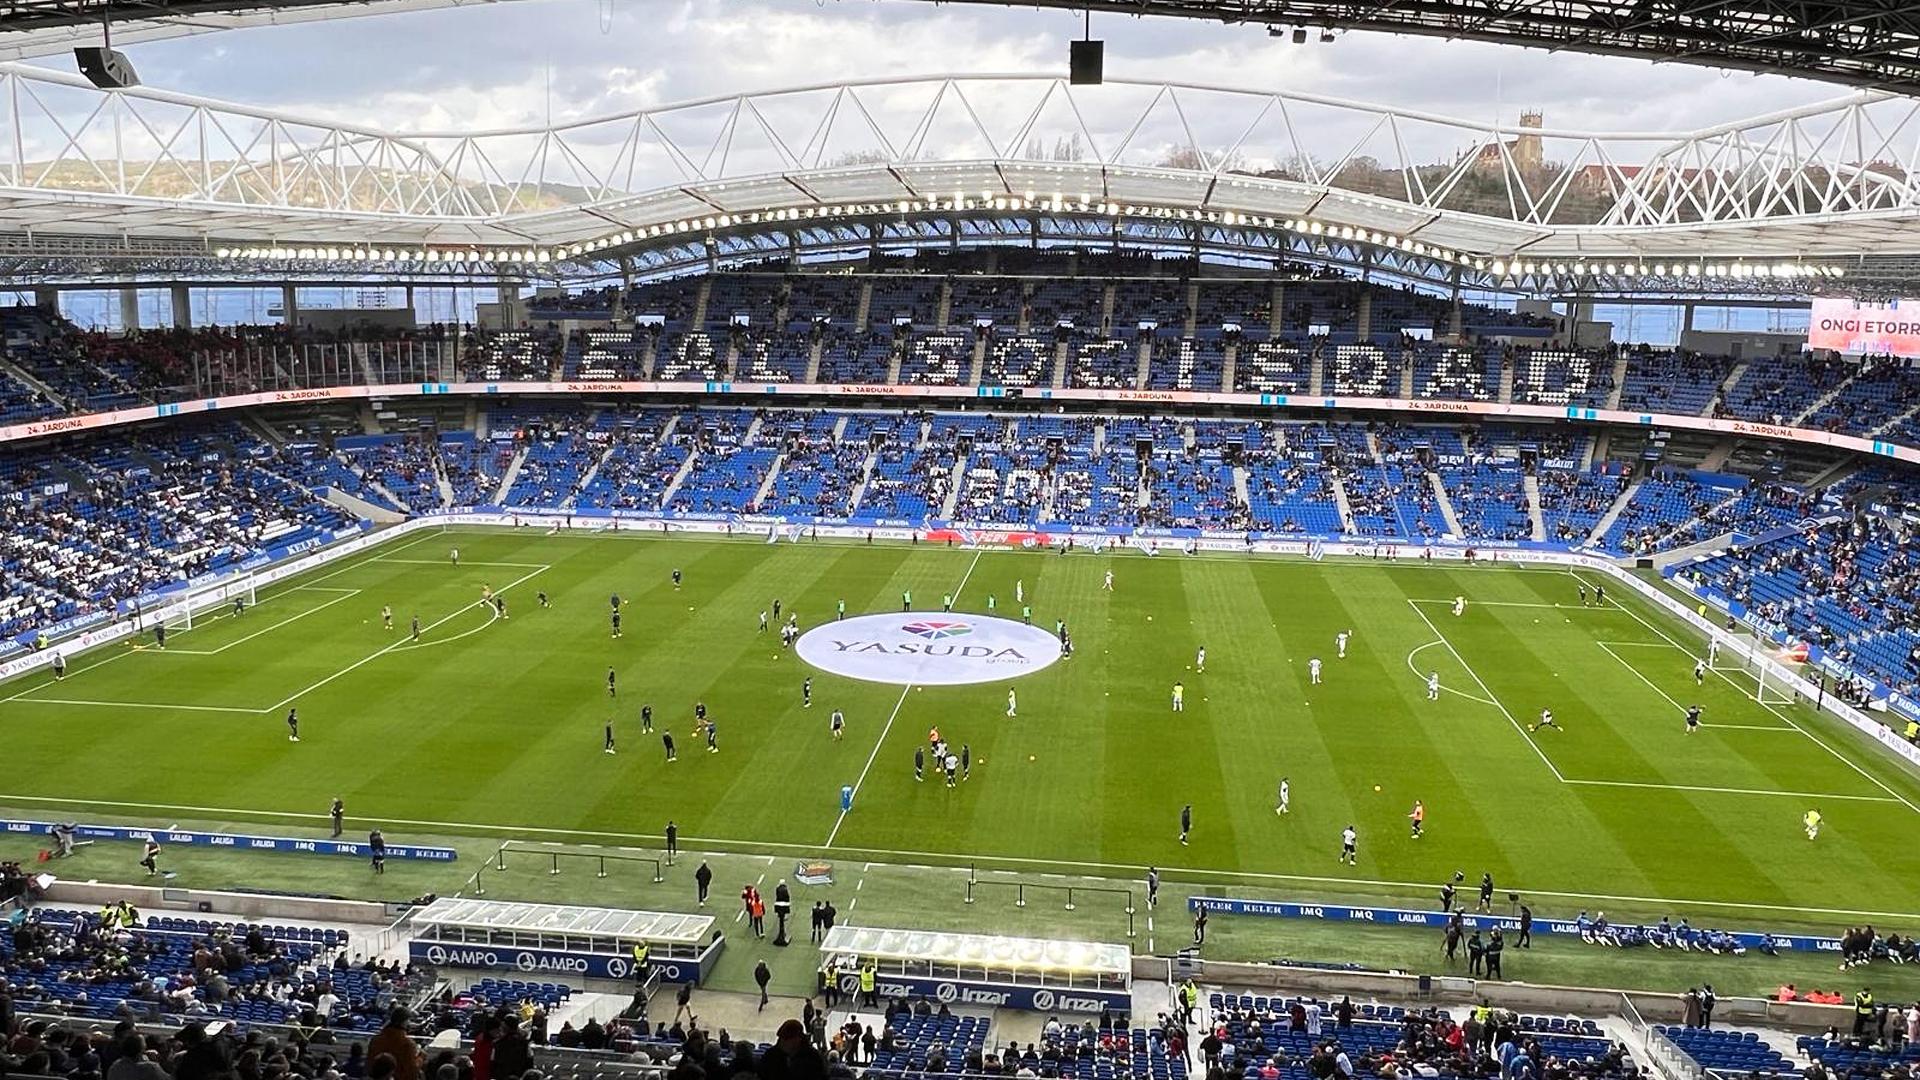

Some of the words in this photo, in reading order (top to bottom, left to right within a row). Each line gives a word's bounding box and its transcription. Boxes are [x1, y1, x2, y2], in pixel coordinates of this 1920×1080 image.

[1821, 318, 1860, 332] ONGI
[902, 335, 1590, 403] SOCIEDAD
[290, 390, 331, 399] JARDUNA
[855, 386, 895, 394] JARDUNA
[1133, 392, 1174, 400] JARDUNA
[1425, 402, 1469, 412] JARDUNA
[42, 419, 83, 433] JARDUNA
[1749, 424, 1794, 438] JARDUNA
[1294, 451, 1314, 460] IMQ
[980, 522, 1029, 530] SOCIEDAD
[287, 536, 322, 556] KELER
[832, 640, 1026, 659] YASUDA
[169, 834, 193, 842] LALIGA
[211, 836, 235, 845] LALIGA
[252, 840, 276, 849] LALIGA
[295, 841, 316, 851] IMQ
[337, 844, 358, 854] IMQ
[415, 849, 450, 859] KELER
[1243, 904, 1282, 914] KELER
[1300, 906, 1324, 918] IMQ
[1350, 910, 1374, 921] IMQ
[1398, 913, 1427, 924] LALIGA
[1552, 923, 1580, 933] LALIGA
[449, 949, 498, 966] AMPO
[539, 956, 588, 973] AMPO
[961, 986, 1011, 1005] Irizar
[1059, 995, 1108, 1012] Irizar
